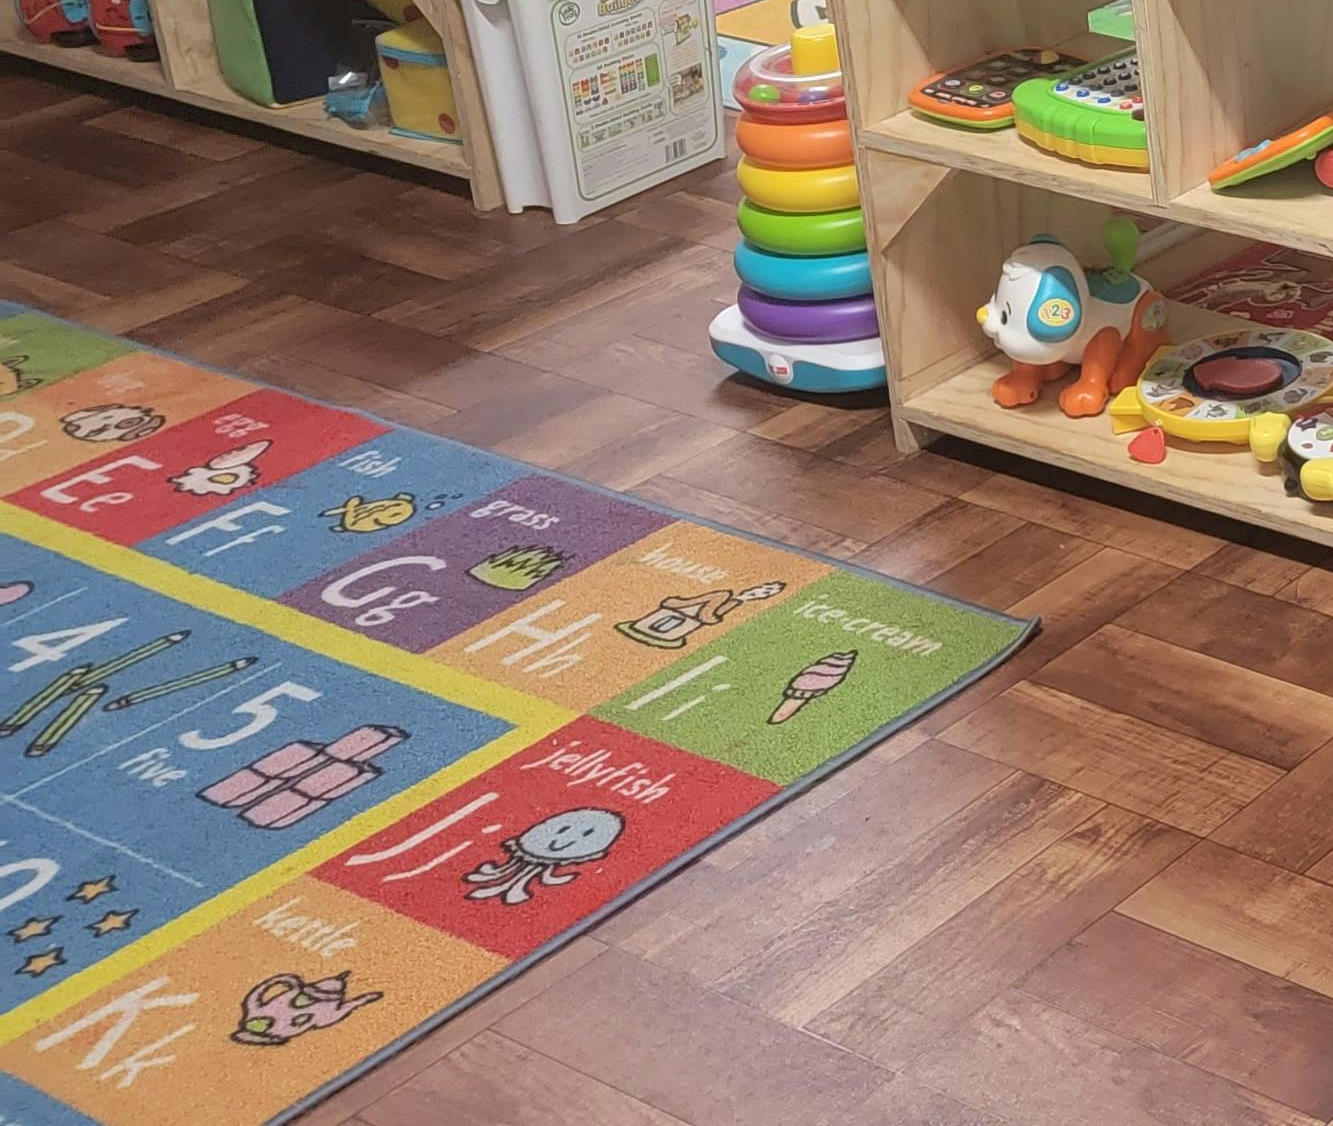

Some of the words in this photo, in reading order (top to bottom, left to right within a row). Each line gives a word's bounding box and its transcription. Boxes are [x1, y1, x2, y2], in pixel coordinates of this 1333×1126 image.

[41, 454, 163, 513] Ee
[337, 448, 403, 479] fish
[165, 500, 293, 557] Ff
[468, 498, 562, 532] grass
[321, 555, 447, 627] Gg
[638, 541, 729, 585] house
[8, 617, 130, 674] 4
[462, 598, 602, 678] Hh
[793, 593, 946, 657] ice-cream
[179, 681, 324, 753] 5
[117, 746, 187, 789] five
[520, 738, 673, 805] jellyfish
[345, 791, 503, 883] Jj
[253, 896, 363, 958] kettle
[34, 974, 201, 1089] Kk
